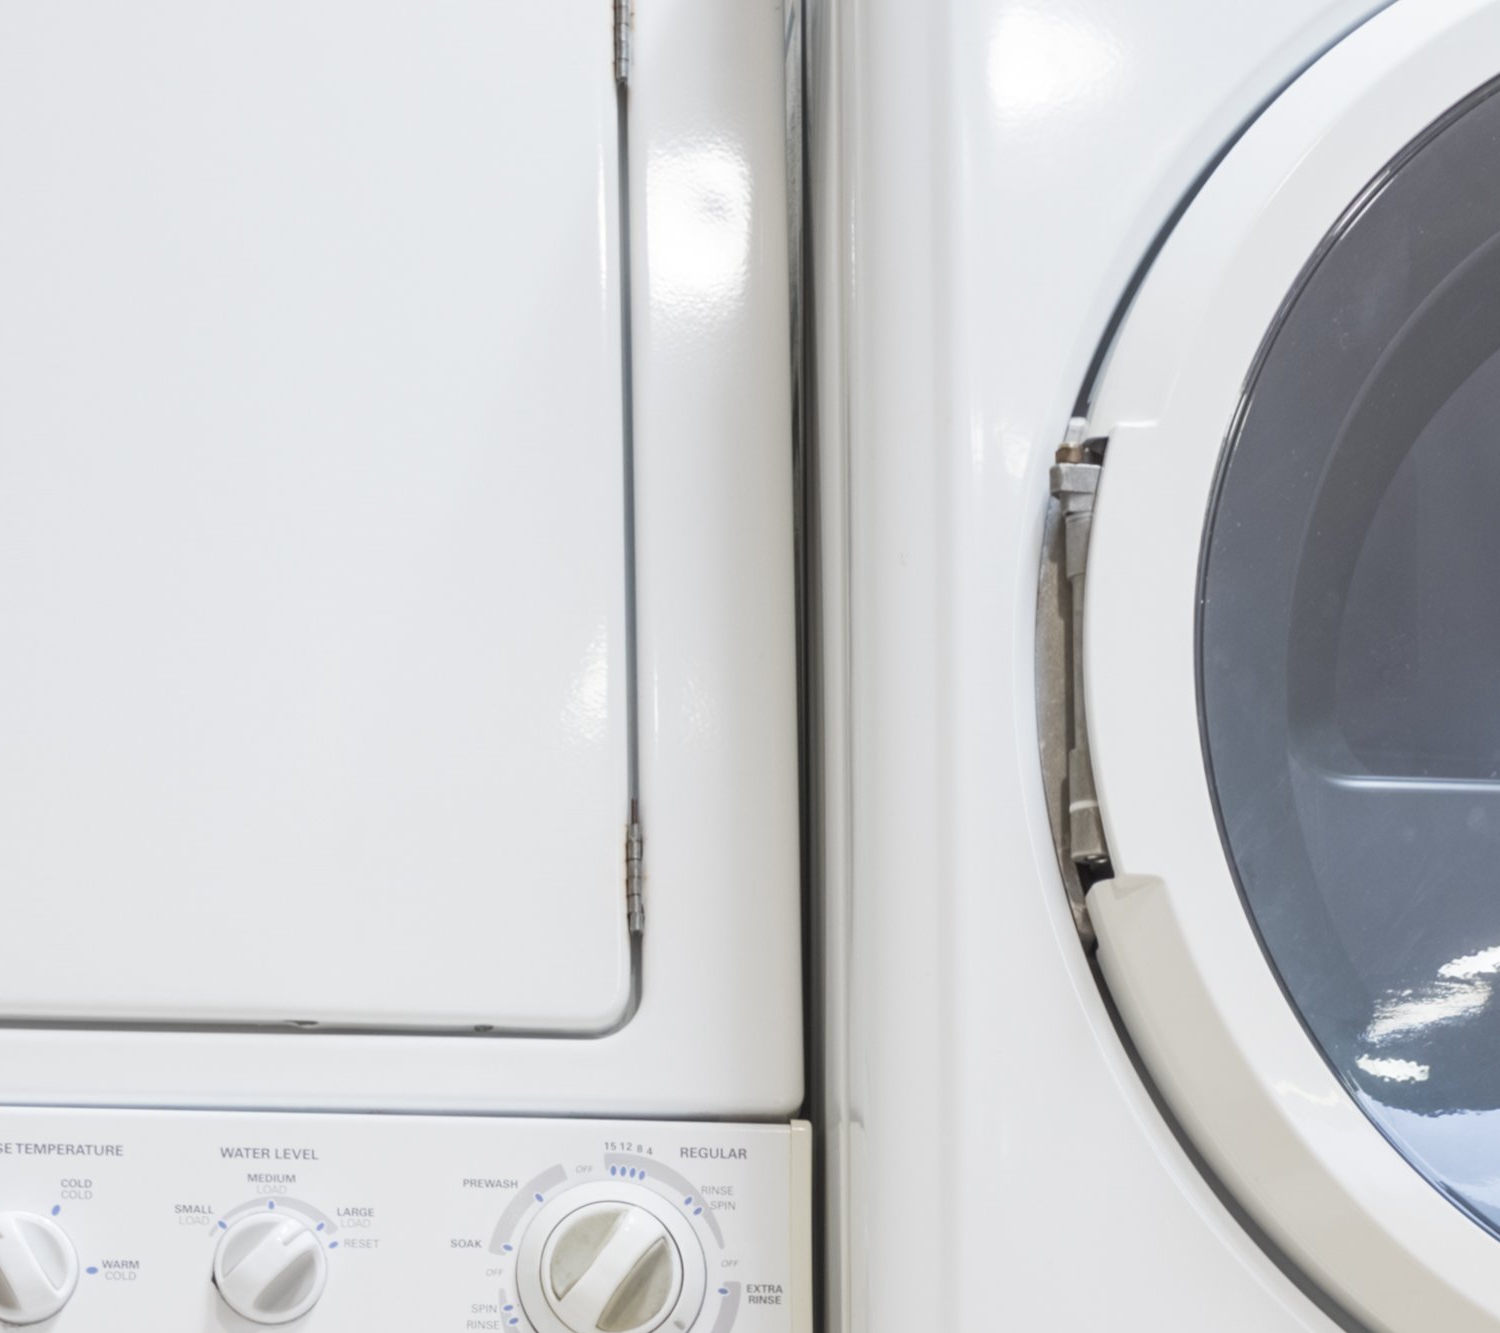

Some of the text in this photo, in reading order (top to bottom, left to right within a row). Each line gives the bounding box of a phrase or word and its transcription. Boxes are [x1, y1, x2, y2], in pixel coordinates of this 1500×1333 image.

[17, 1142, 123, 1157] TEMPERATURE
[604, 1142, 653, 1155] 15 12 8 4
[680, 1147, 747, 1159] REGULAR
[220, 1147, 318, 1162] WATER LEVEL
[61, 1178, 93, 1189] COLD
[247, 1173, 296, 1184] MEDIUM
[463, 1179, 518, 1189] PREWASH
[61, 1189, 93, 1200] COLD
[256, 1183, 288, 1195] LOAD
[701, 1186, 733, 1195] RINSE
[175, 1204, 214, 1215] SMALL
[710, 1201, 736, 1211] SPIN
[337, 1207, 374, 1219] LARGE
[179, 1215, 210, 1226] LOAD
[340, 1218, 371, 1229] LOAD
[343, 1238, 380, 1249] RESET
[450, 1239, 482, 1249] SOAK
[101, 1259, 140, 1271] WARM
[104, 1271, 137, 1282] COLD
[746, 1284, 783, 1294] EXTRA
[748, 1295, 782, 1305] RINSE
[471, 1304, 497, 1313] SPIN
[467, 1320, 500, 1330] RINSE
